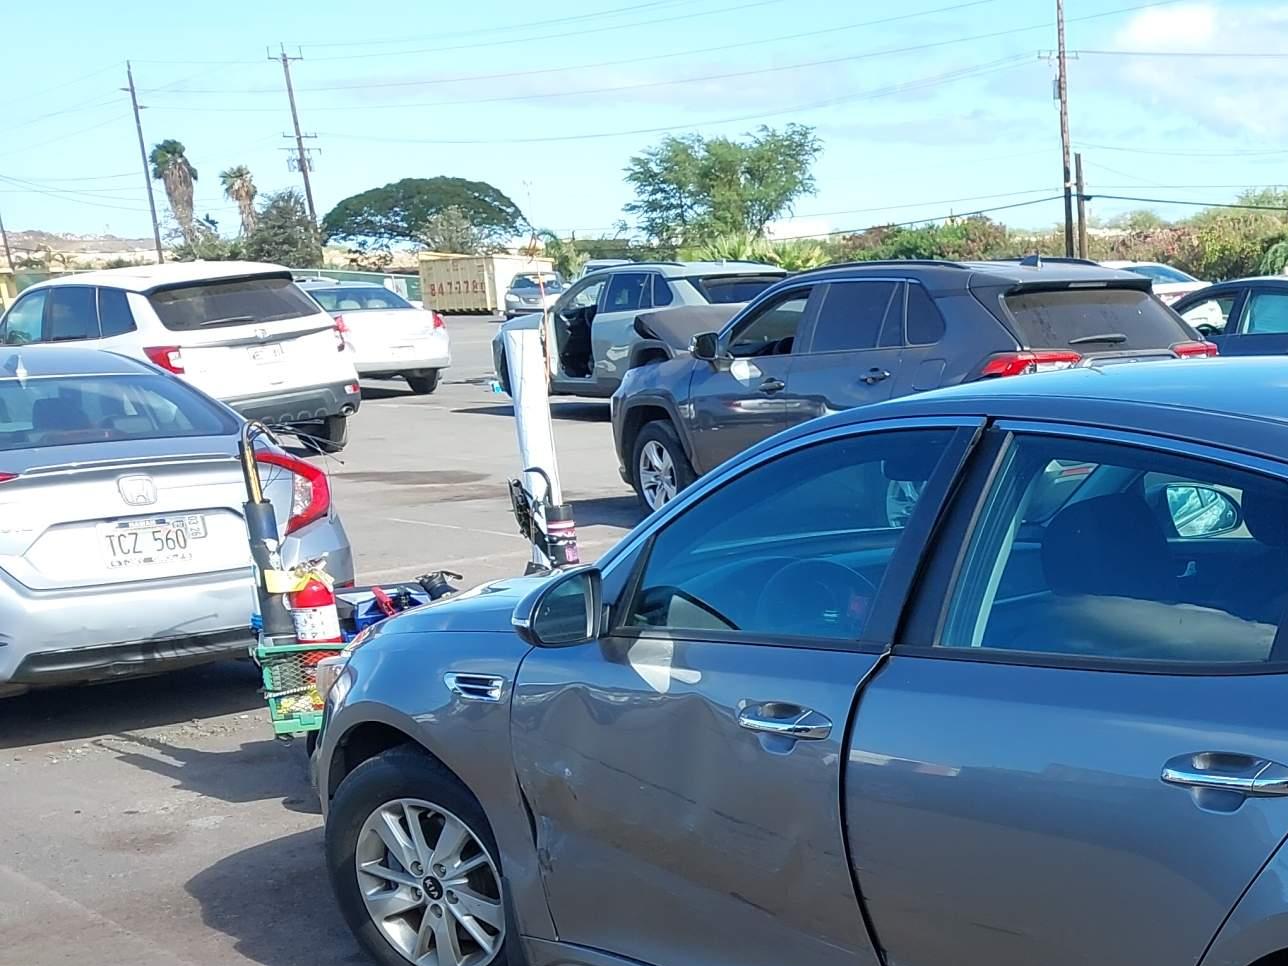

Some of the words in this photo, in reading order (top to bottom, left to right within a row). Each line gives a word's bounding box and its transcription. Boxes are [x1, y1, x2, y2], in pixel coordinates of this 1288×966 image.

[106, 532, 143, 556] TCZ
[152, 528, 187, 552] 560
[424, 879, 439, 899] KIA
